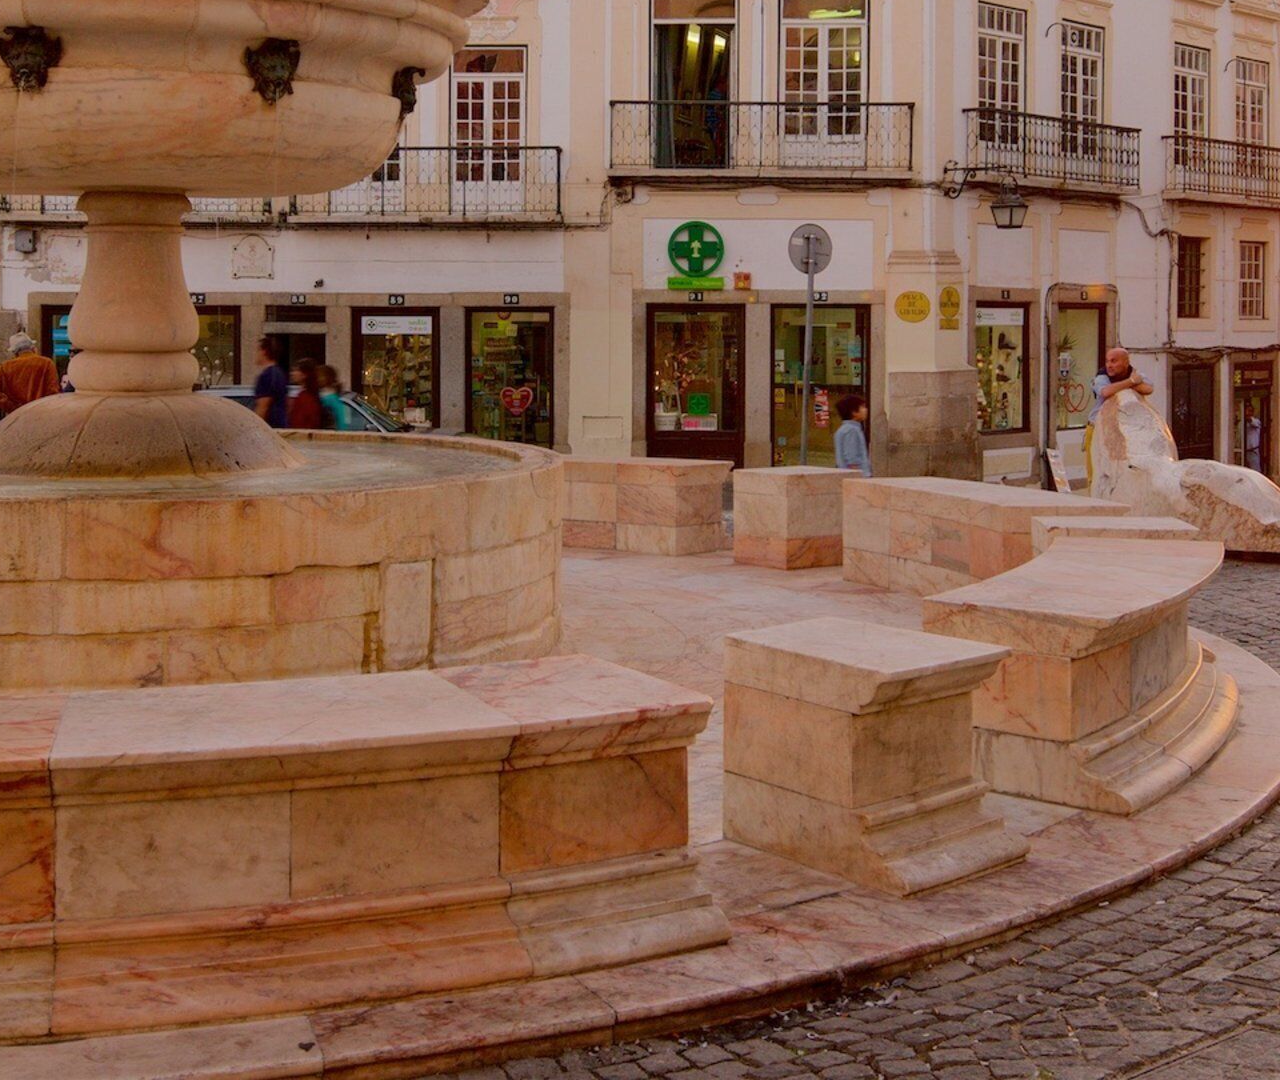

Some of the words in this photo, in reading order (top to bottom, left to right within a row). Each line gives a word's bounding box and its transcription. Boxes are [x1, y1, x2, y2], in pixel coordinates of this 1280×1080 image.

[291, 294, 305, 303] 88
[390, 295, 404, 305] 89
[504, 295, 518, 304] 90
[689, 292, 702, 301] 91
[813, 292, 828, 301] 92
